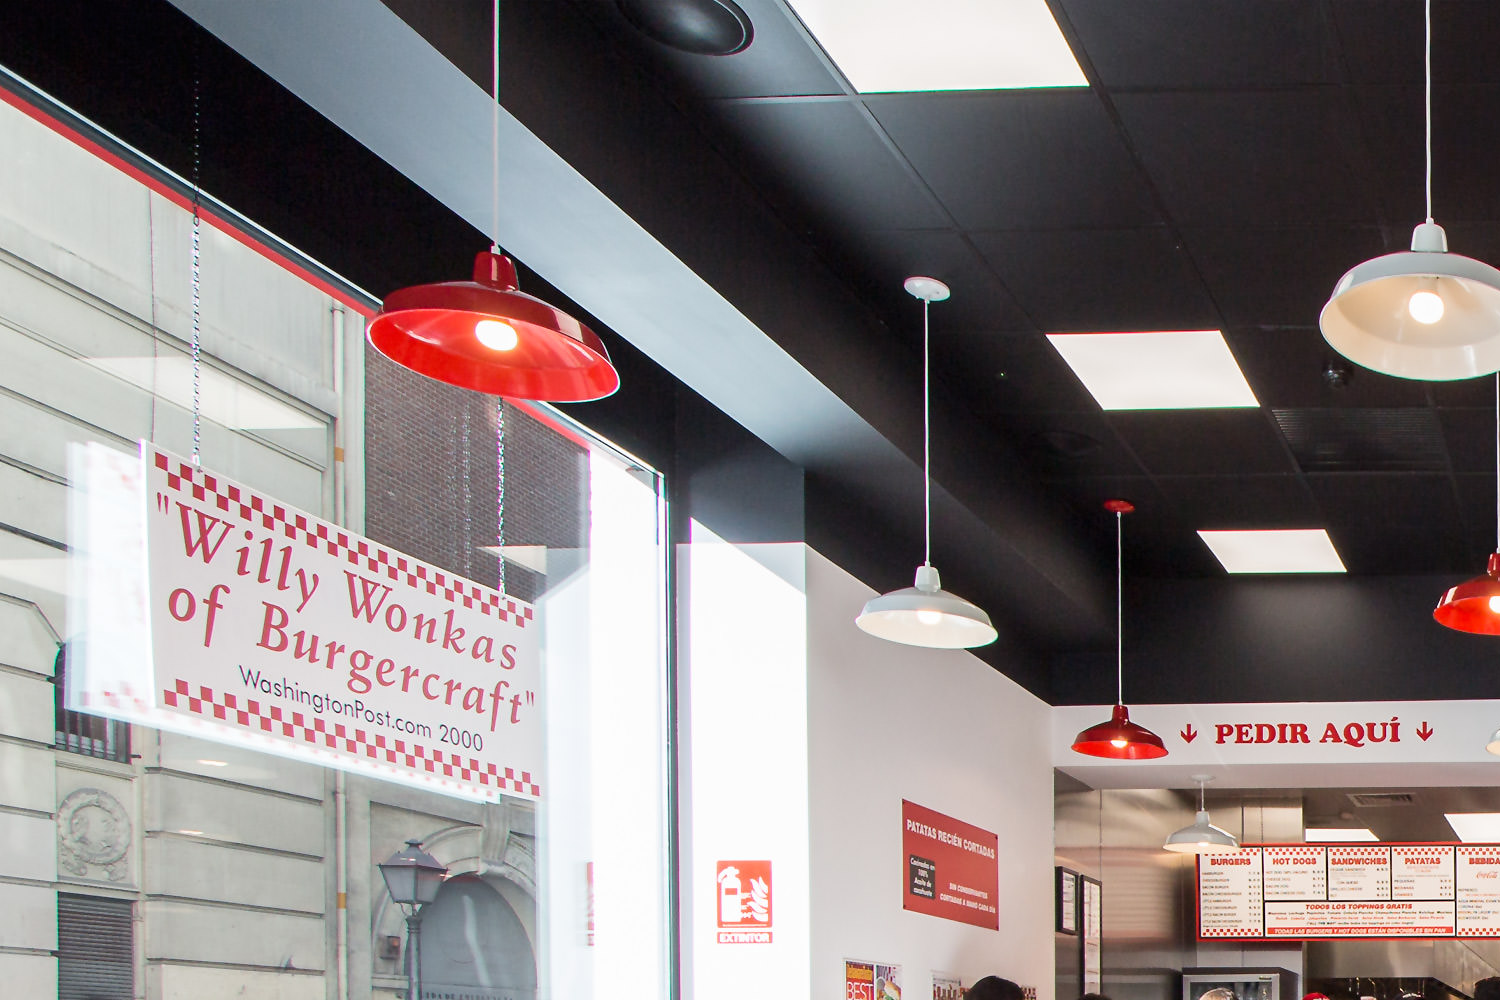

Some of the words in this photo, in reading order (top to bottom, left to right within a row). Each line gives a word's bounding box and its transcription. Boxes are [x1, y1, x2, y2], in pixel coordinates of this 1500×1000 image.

[156, 491, 320, 612] "Willy
[343, 568, 518, 671] Wonkas
[168, 583, 232, 648] of
[256, 600, 535, 732] Burgercraft"
[238, 664, 432, 739] WashingtonPost.com
[438, 722, 484, 752] 2000
[1215, 723, 1310, 744] PEDIR
[1319, 716, 1401, 747] AQUÍ
[906, 819, 937, 839] PATATAS
[938, 830, 962, 848] RECIÉN
[963, 840, 995, 859] CORTADAS
[1210, 858, 1251, 866] BURGERS
[1331, 857, 1388, 865] SANDWICHES
[1404, 857, 1441, 865] PATATAS
[719, 932, 770, 943] EXTINTOR
